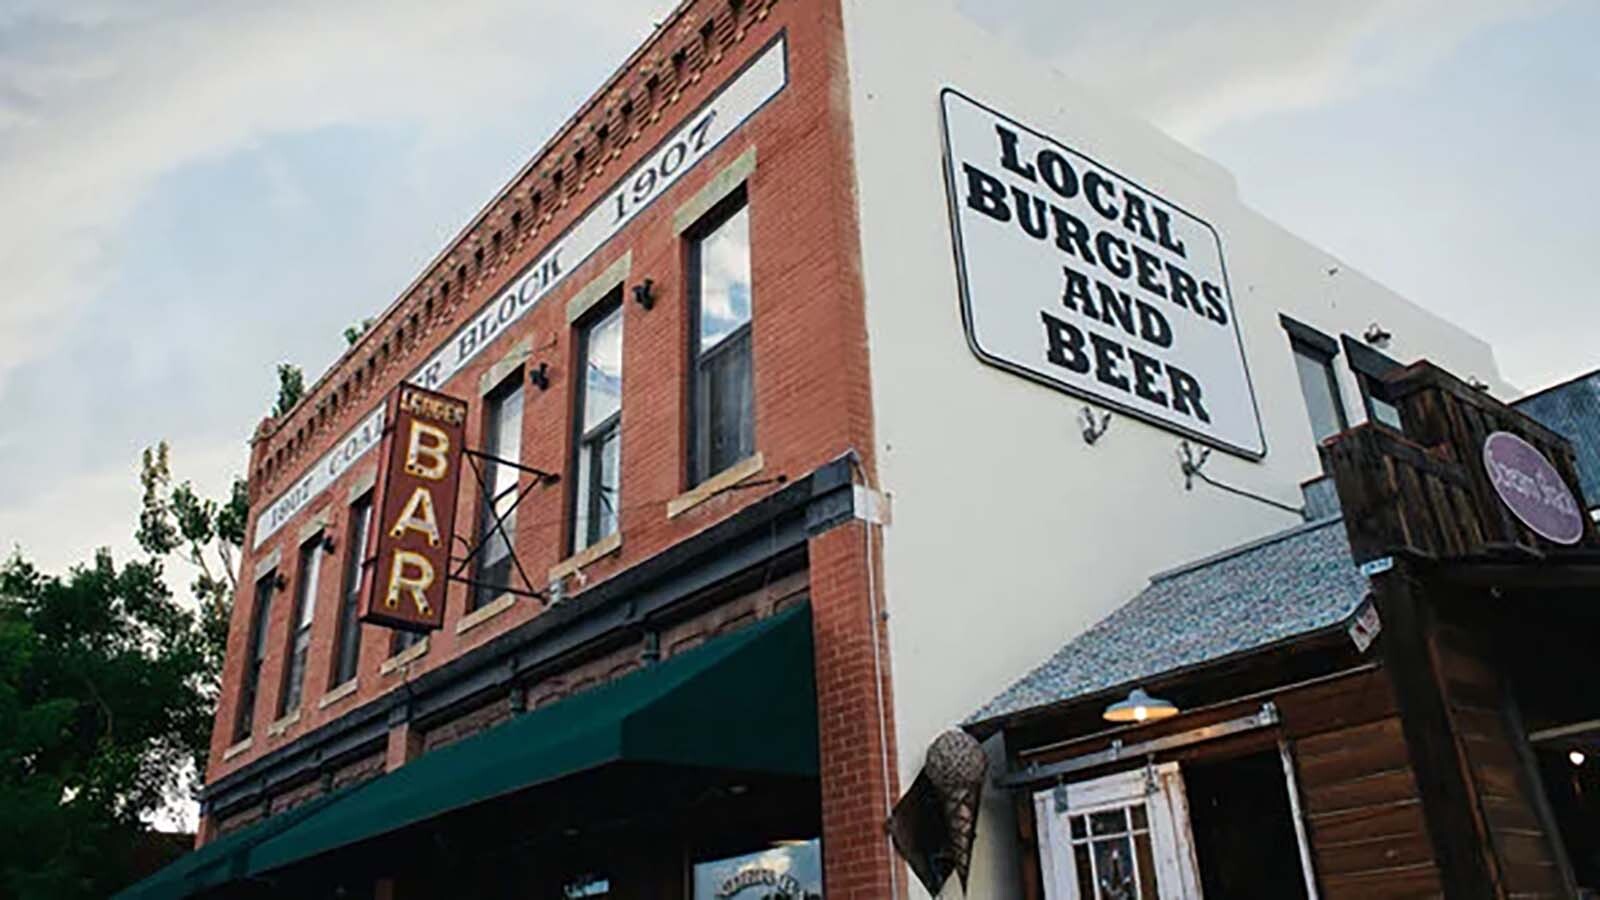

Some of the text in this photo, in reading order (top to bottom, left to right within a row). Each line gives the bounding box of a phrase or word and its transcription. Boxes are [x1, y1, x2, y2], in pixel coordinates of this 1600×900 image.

[455, 246, 564, 363] BLOCK
[613, 108, 718, 224] 1907
[962, 161, 1229, 326] BURGERS
[995, 123, 1187, 259] LOCAL
[1040, 310, 1211, 425] BEER
[1061, 264, 1173, 349] AND
[385, 418, 452, 617] BAR
